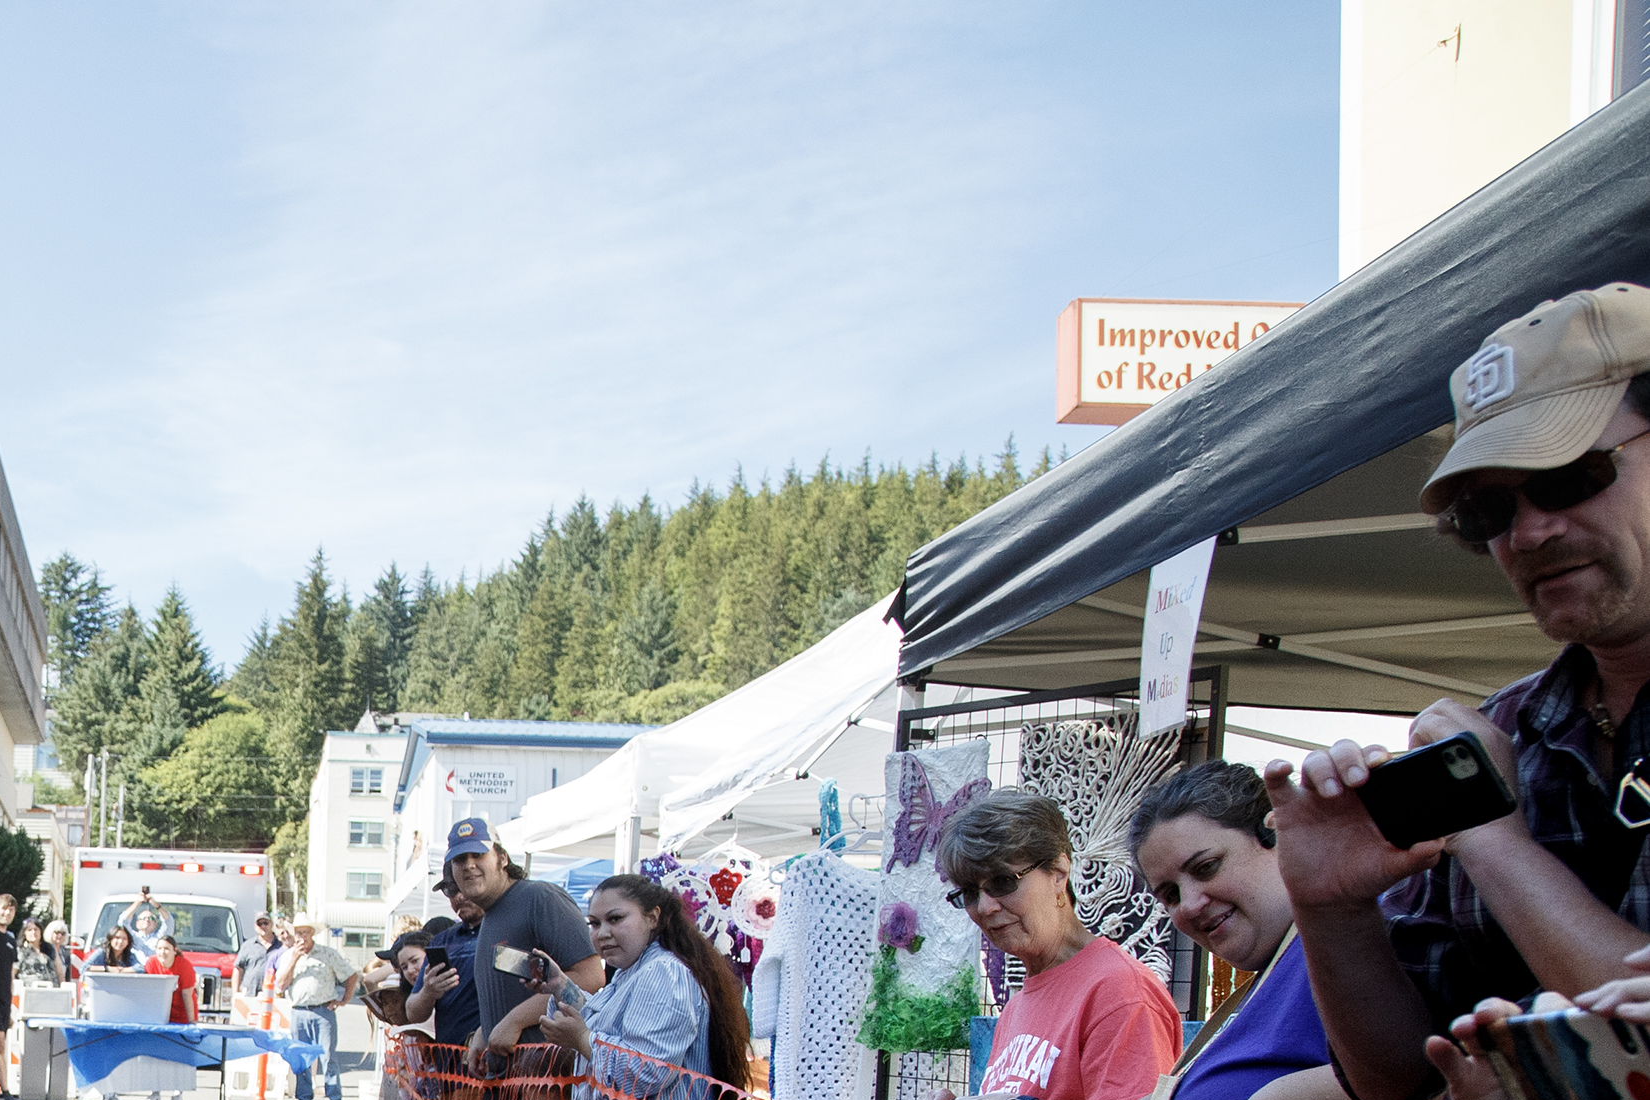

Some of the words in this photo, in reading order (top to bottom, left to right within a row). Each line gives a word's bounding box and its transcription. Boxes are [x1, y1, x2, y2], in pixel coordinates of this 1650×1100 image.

[1097, 318, 1240, 356] Improved
[1096, 361, 1130, 390] of
[1137, 362, 1192, 391] Red
[1159, 631, 1174, 660] Up
[459, 779, 515, 787] METHODIST
